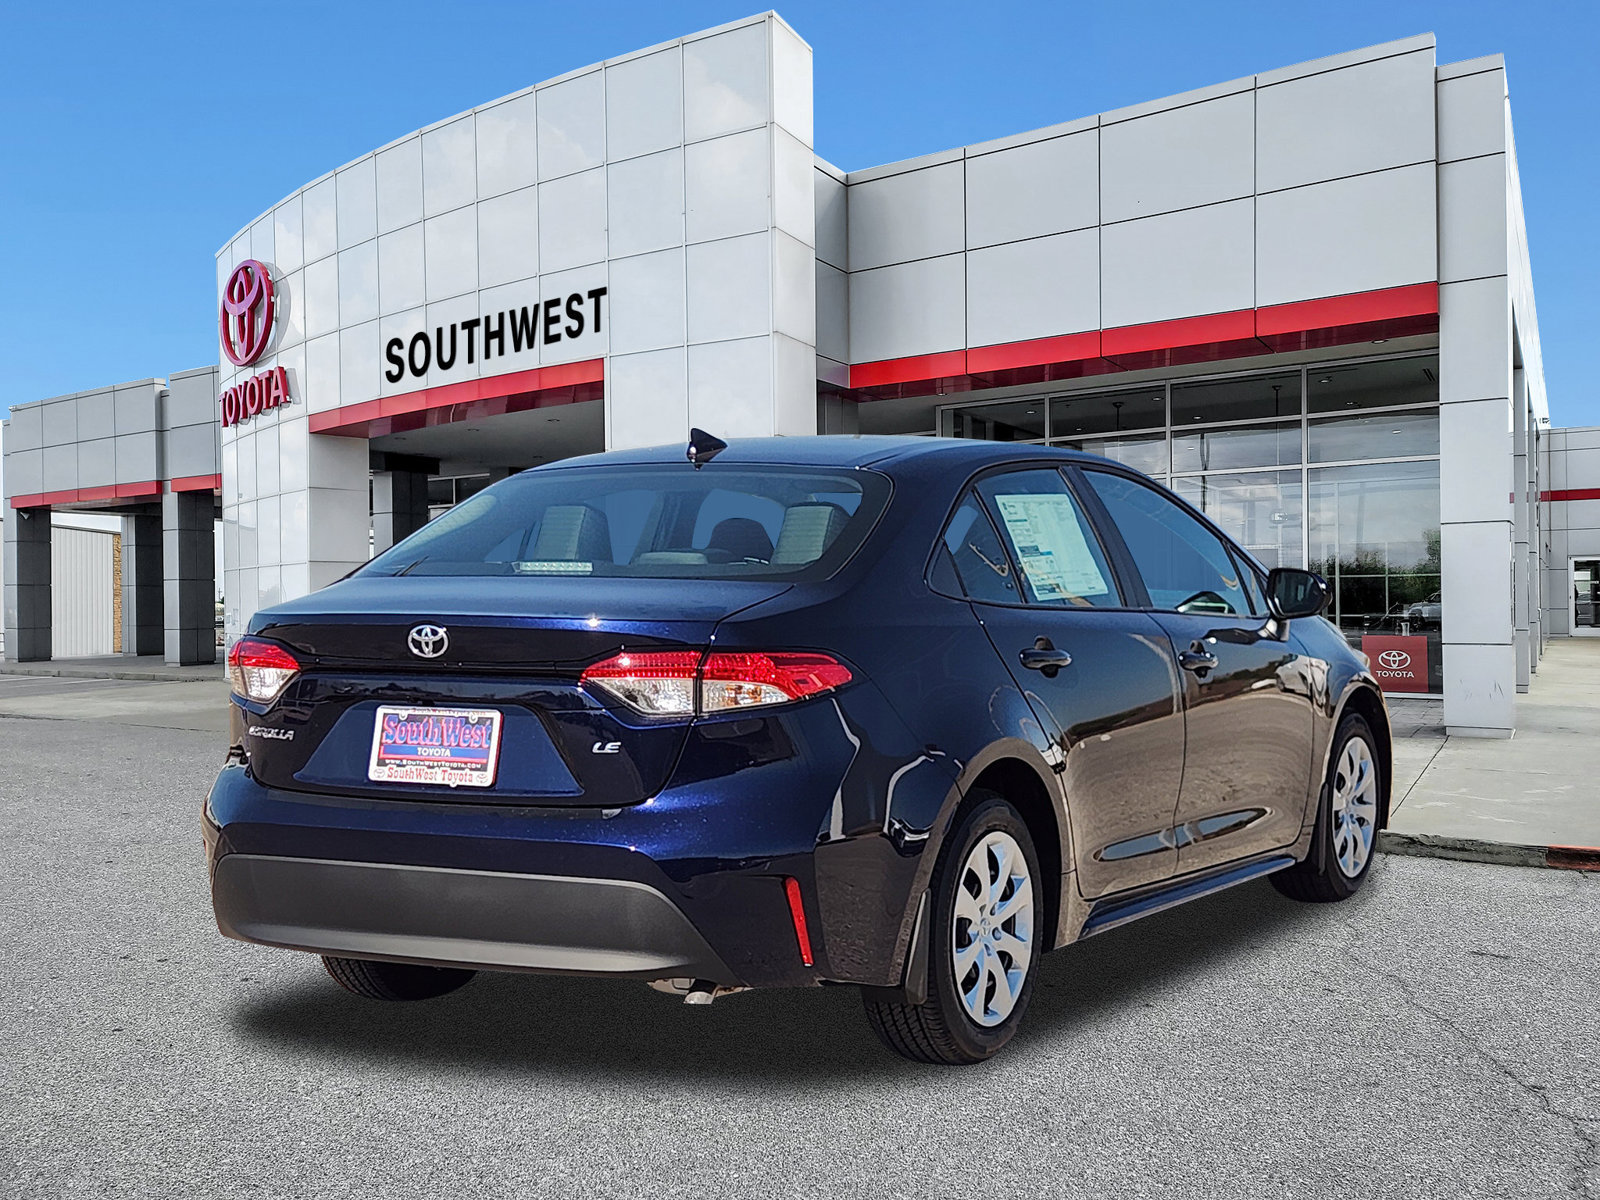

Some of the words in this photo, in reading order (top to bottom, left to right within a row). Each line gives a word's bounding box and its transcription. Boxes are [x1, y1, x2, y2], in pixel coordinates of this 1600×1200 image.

[385, 286, 608, 384] SOUTHWEST
[219, 366, 291, 427] TOYOTA
[1376, 670, 1415, 678] TOYOTA
[417, 747, 451, 757] TOYOTA
[592, 741, 622, 754] LE
[441, 769, 474, 784] Toyota
